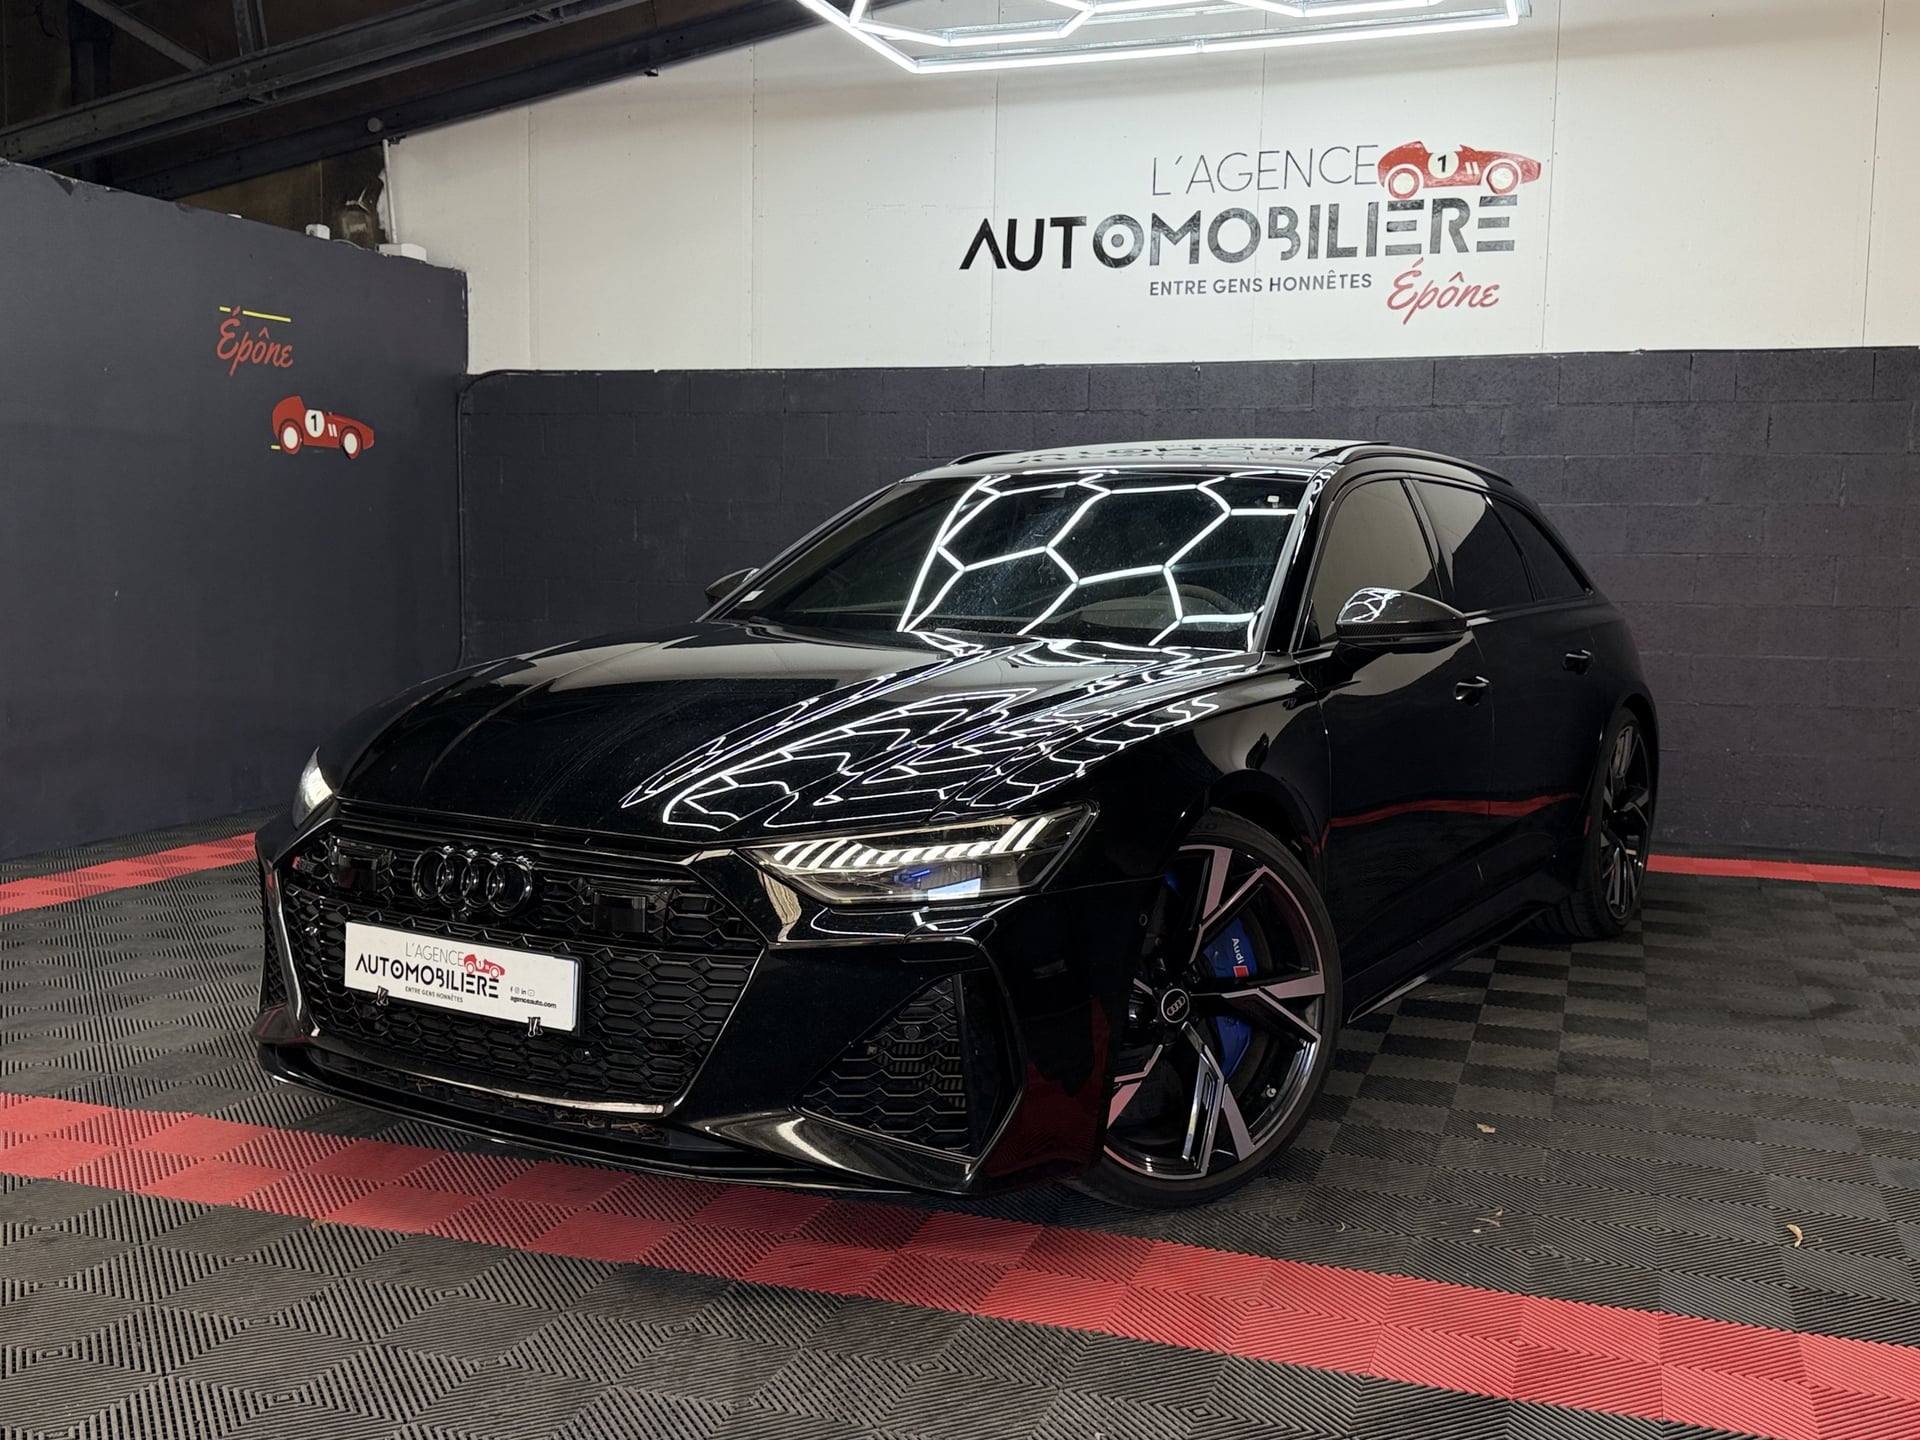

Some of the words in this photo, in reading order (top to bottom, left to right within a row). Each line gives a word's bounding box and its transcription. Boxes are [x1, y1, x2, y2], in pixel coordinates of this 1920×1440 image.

[1152, 144, 1379, 196] L'AGENCE
[1437, 154, 1449, 173] 1
[1149, 279, 1207, 296] ENTRE
[1213, 277, 1263, 294] GENS
[1269, 270, 1372, 292] HONNÊTES
[1385, 257, 1500, 325] Épône
[216, 305, 294, 376] Épône
[310, 413, 318, 432] 1
[405, 941, 464, 967] L'AGENCE
[1231, 937, 1245, 964] Audi
[405, 985, 420, 994] ENTRE
[421, 989, 435, 998] GENS
[510, 995, 557, 1009] agenceauto.com
